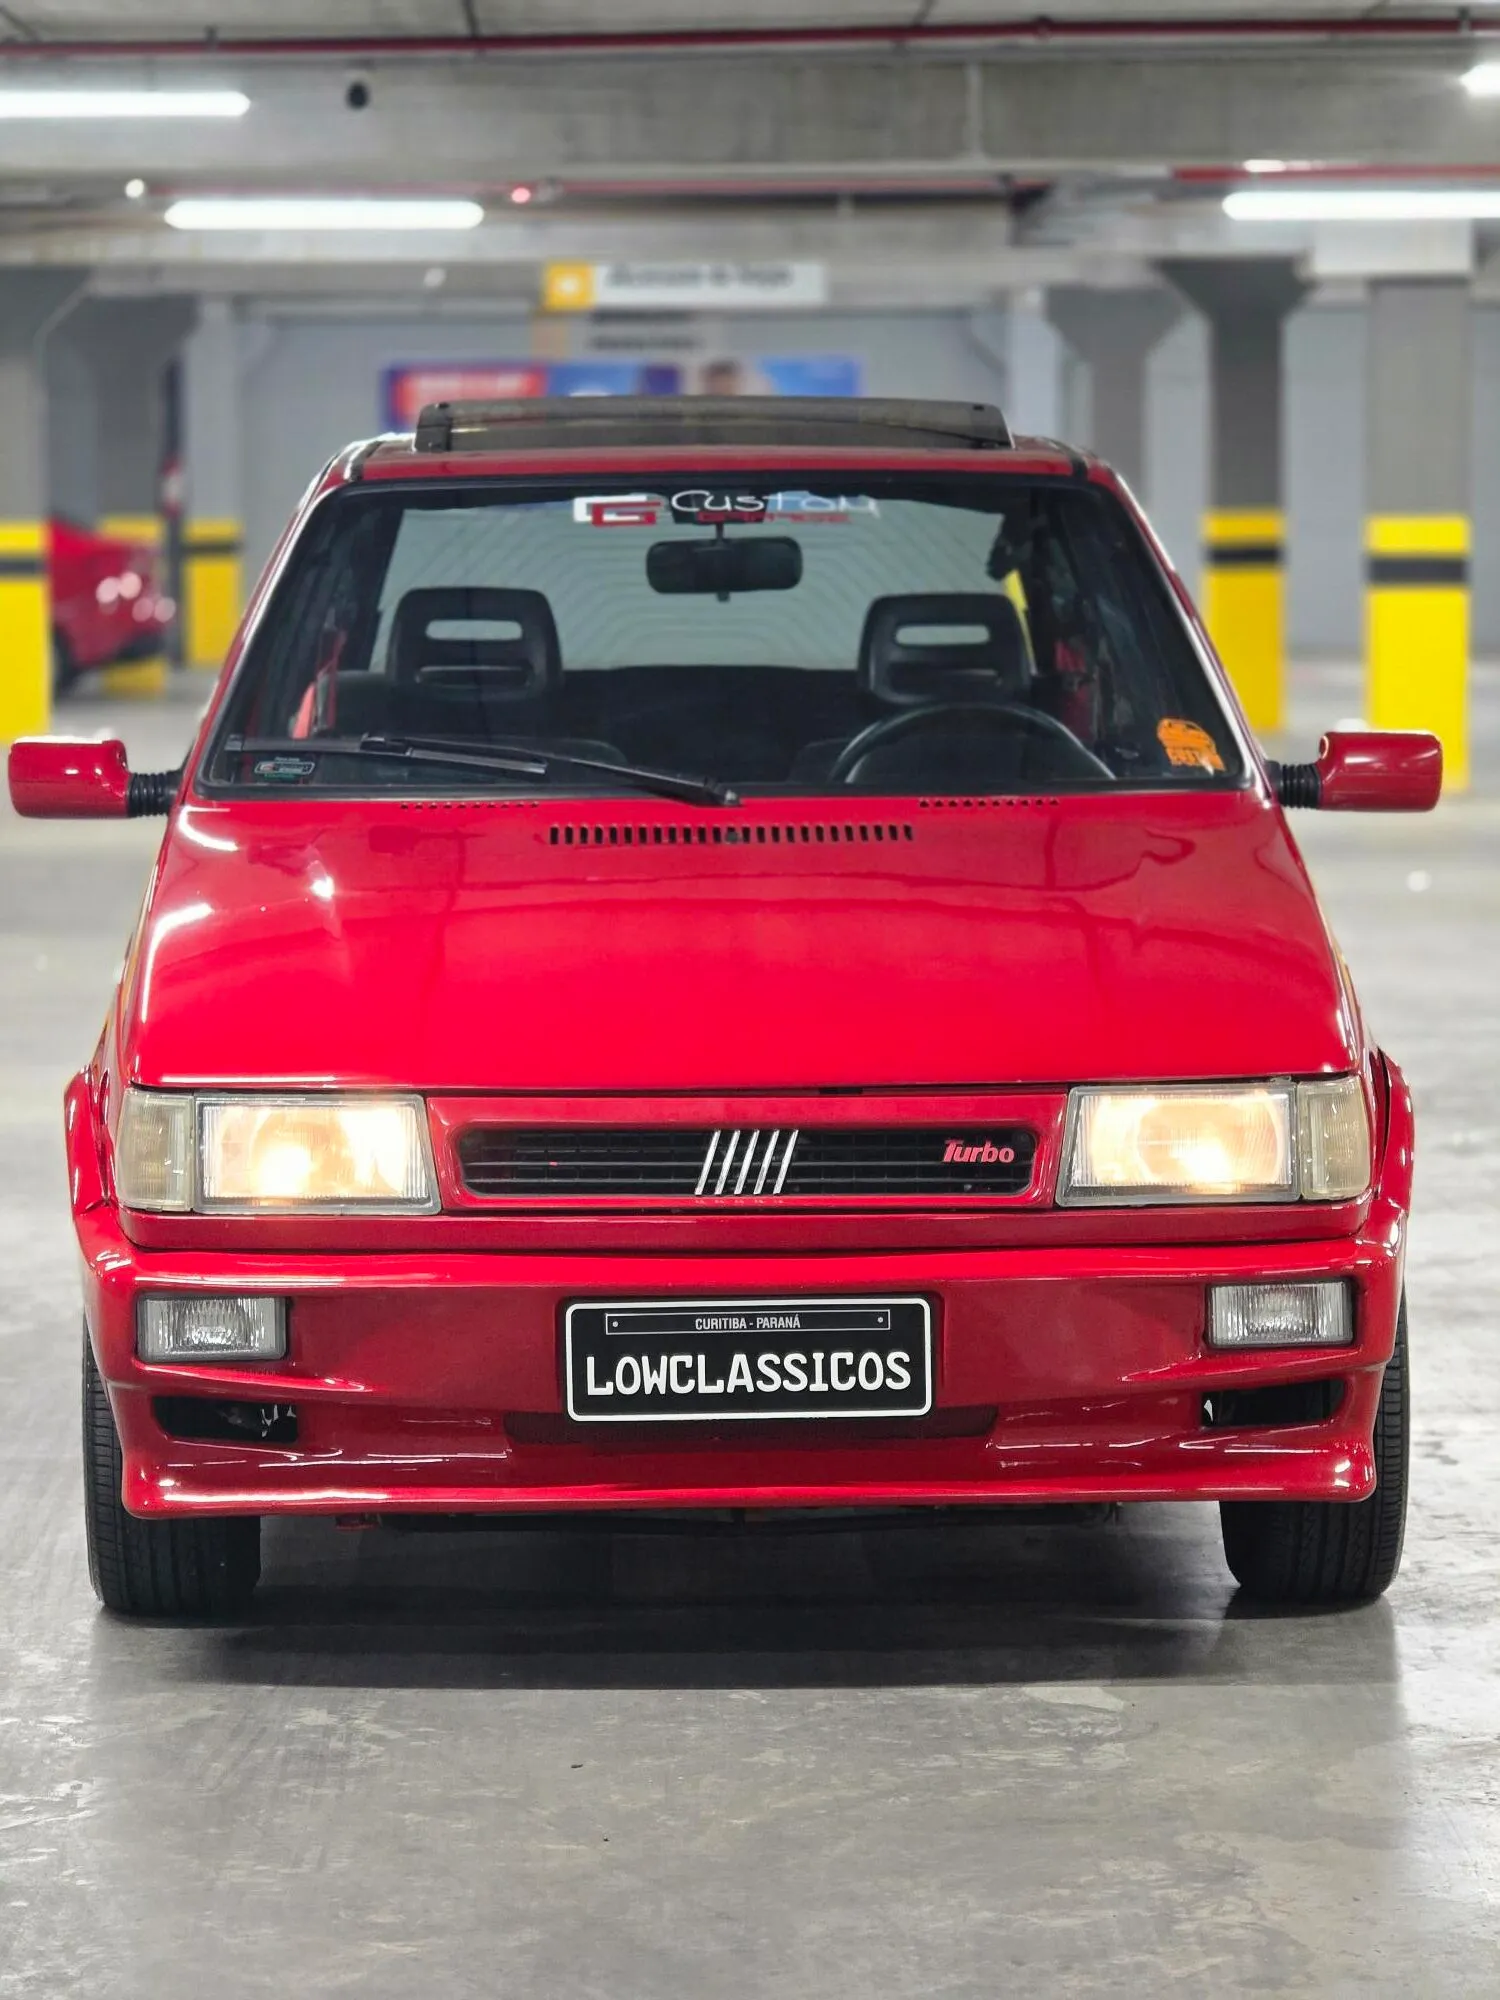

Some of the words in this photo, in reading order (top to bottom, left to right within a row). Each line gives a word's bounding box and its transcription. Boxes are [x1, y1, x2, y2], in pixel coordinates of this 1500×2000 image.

[943, 1139, 1015, 1163] Turbo
[695, 1317, 747, 1331] CURITIBA
[756, 1314, 801, 1330] PARANÁ
[586, 1351, 911, 1396] LOWCLASSICOS
